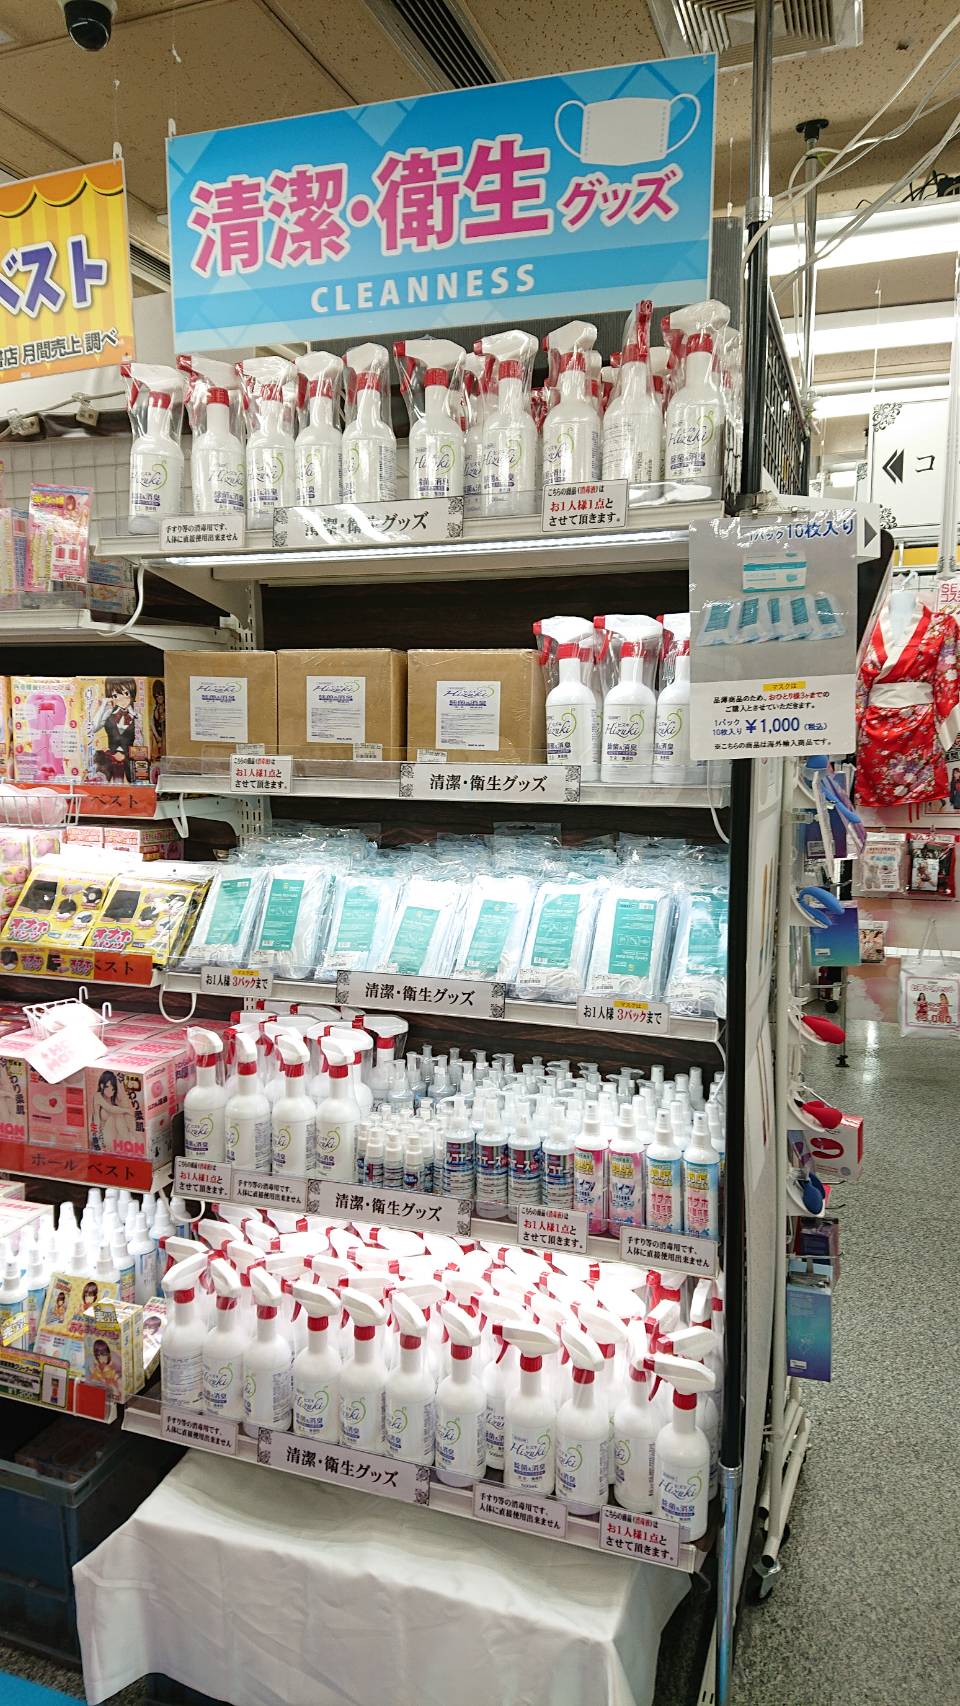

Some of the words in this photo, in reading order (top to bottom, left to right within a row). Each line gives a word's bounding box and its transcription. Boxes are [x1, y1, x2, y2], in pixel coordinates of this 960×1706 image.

[190, 135, 681, 277] 清潔・衛生グッズ
[311, 264, 536, 313] CLEANNESS
[0, 346, 18, 367] 店
[22, 335, 82, 364] 月間売上
[84, 329, 118, 354] 調べ
[551, 498, 613, 512] お1人様1点と
[549, 512, 621, 527] させて頂きます。
[941, 583, 960, 593] SE
[941, 593, 960, 603] コス
[605, 722, 640, 738] Hizuki
[746, 716, 801, 734] ¥1,000
[236, 768, 282, 778] お1人様1点と
[429, 773, 548, 793] 清潔・衛生グッズ
[91, 794, 138, 809] ベスト
[365, 982, 475, 1006] 清潔・衛生グッズ
[617, 1008, 662, 1025] 3パックまで
[31, 1153, 78, 1171] ホール
[88, 1163, 135, 1181] ベスト
[335, 1192, 443, 1222] 清潔・衛生グッズ
[523, 1220, 577, 1236] お1人様1点と
[522, 1232, 583, 1249] させて頂きます。
[626, 1247, 710, 1268] 人体に直接使用出来ません
[510, 1441, 546, 1460] Hizuki
[286, 1446, 399, 1488] 清潔・衛生グッズ
[658, 1478, 697, 1500] Hizuki
[608, 1523, 667, 1546] お1人様1点と
[606, 1536, 674, 1561] させて頂きます。
